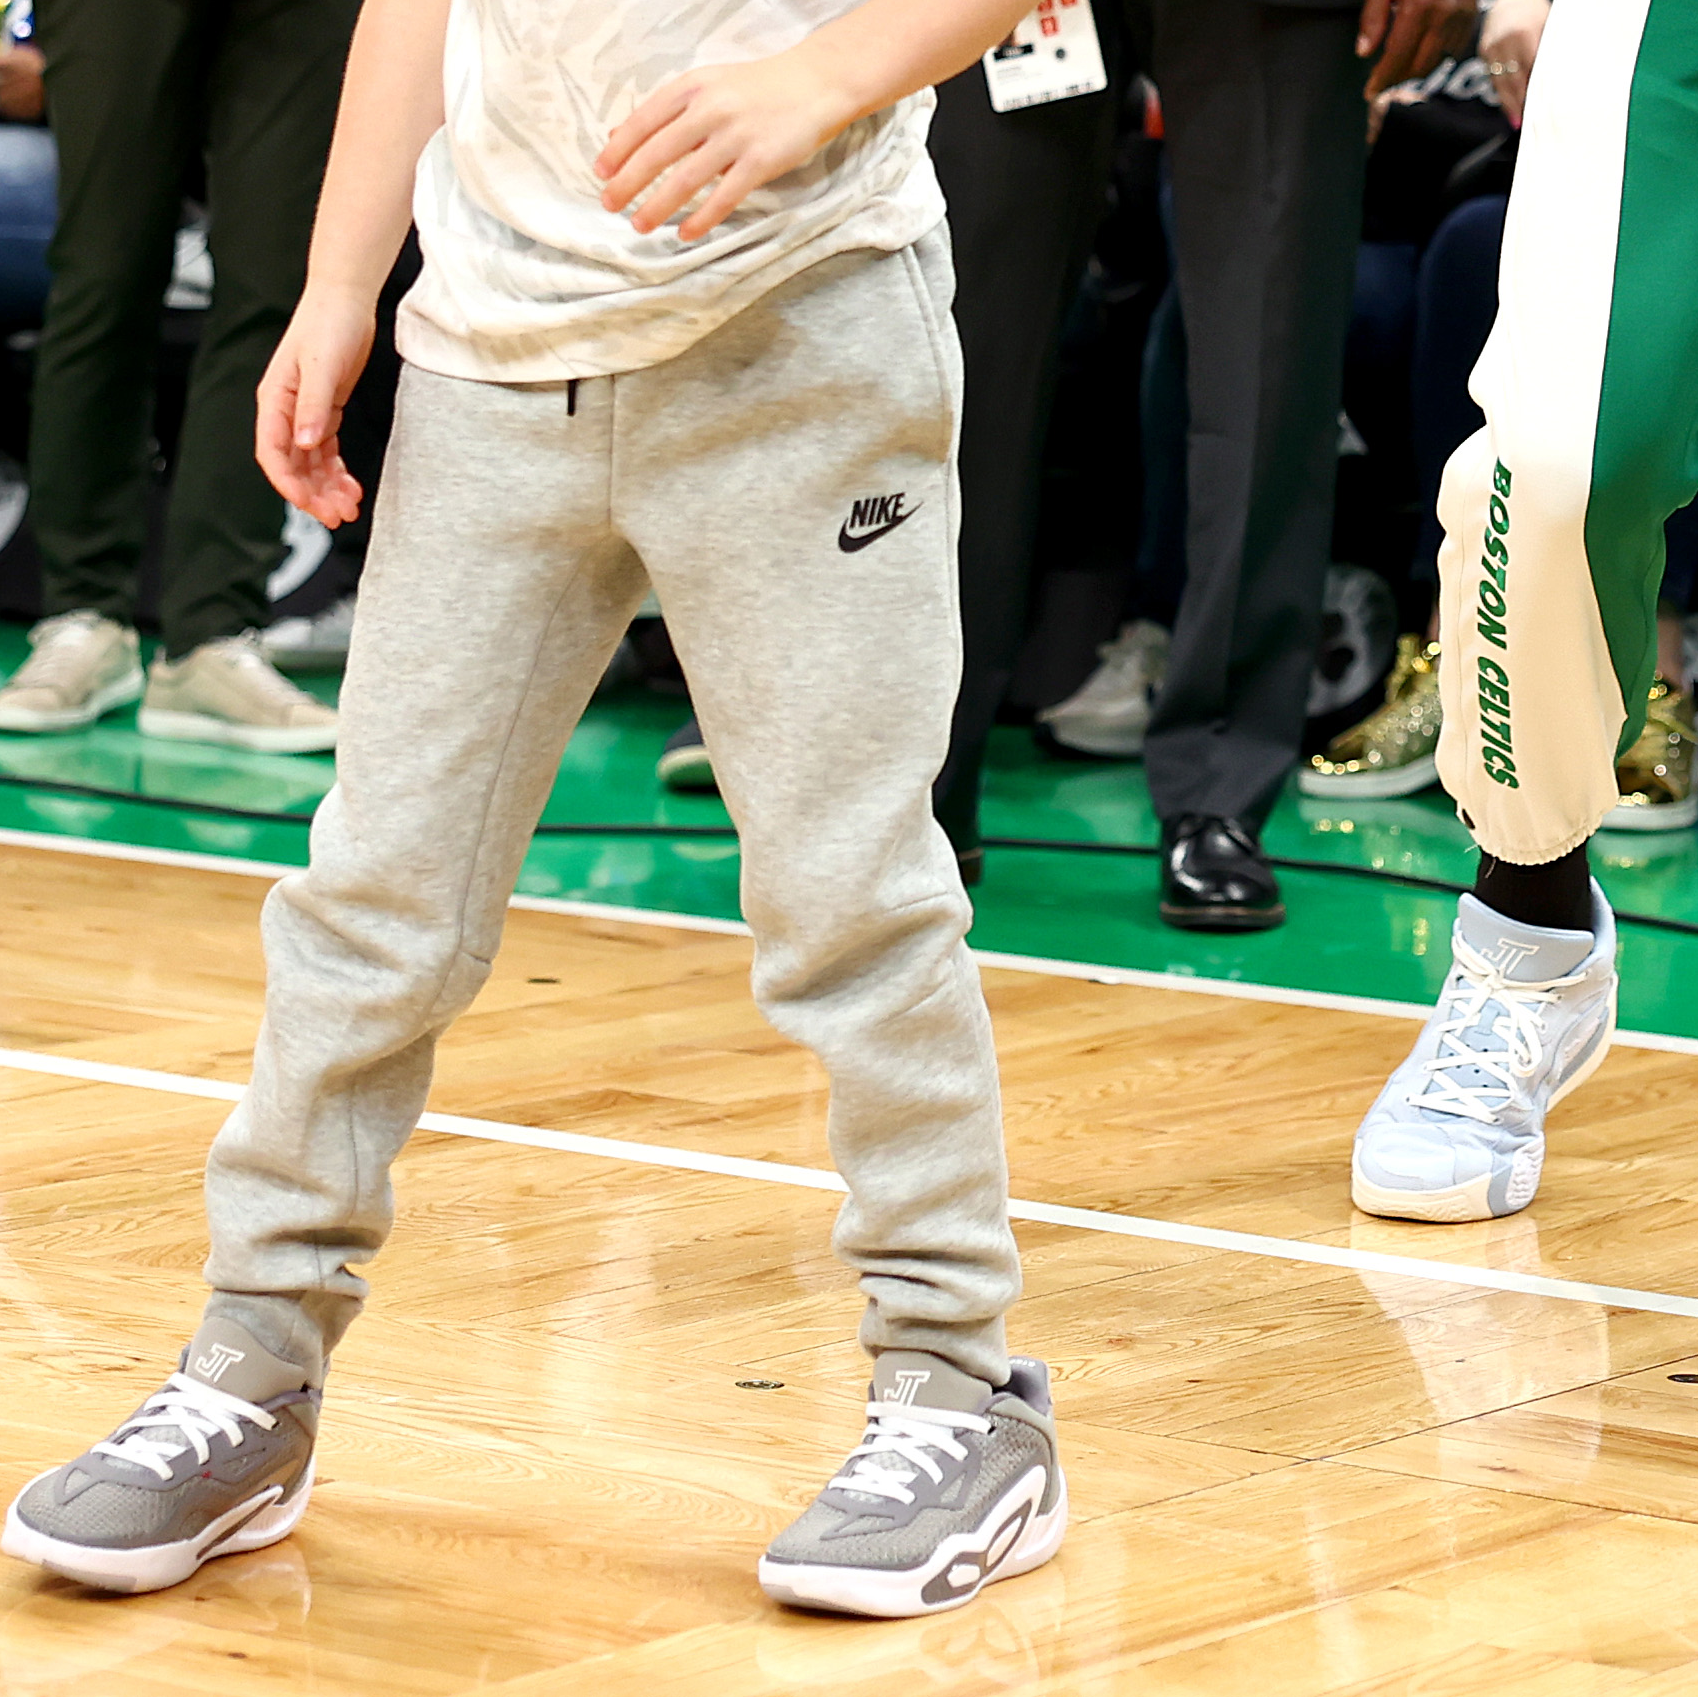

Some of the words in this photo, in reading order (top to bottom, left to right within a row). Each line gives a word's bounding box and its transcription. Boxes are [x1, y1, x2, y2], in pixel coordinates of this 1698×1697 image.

[848, 491, 906, 531] NIKE
[1476, 455, 1512, 651] BOSTON
[1476, 655, 1520, 790] CELTICS
[194, 1342, 246, 1384] JT
[883, 1369, 932, 1407] JT
